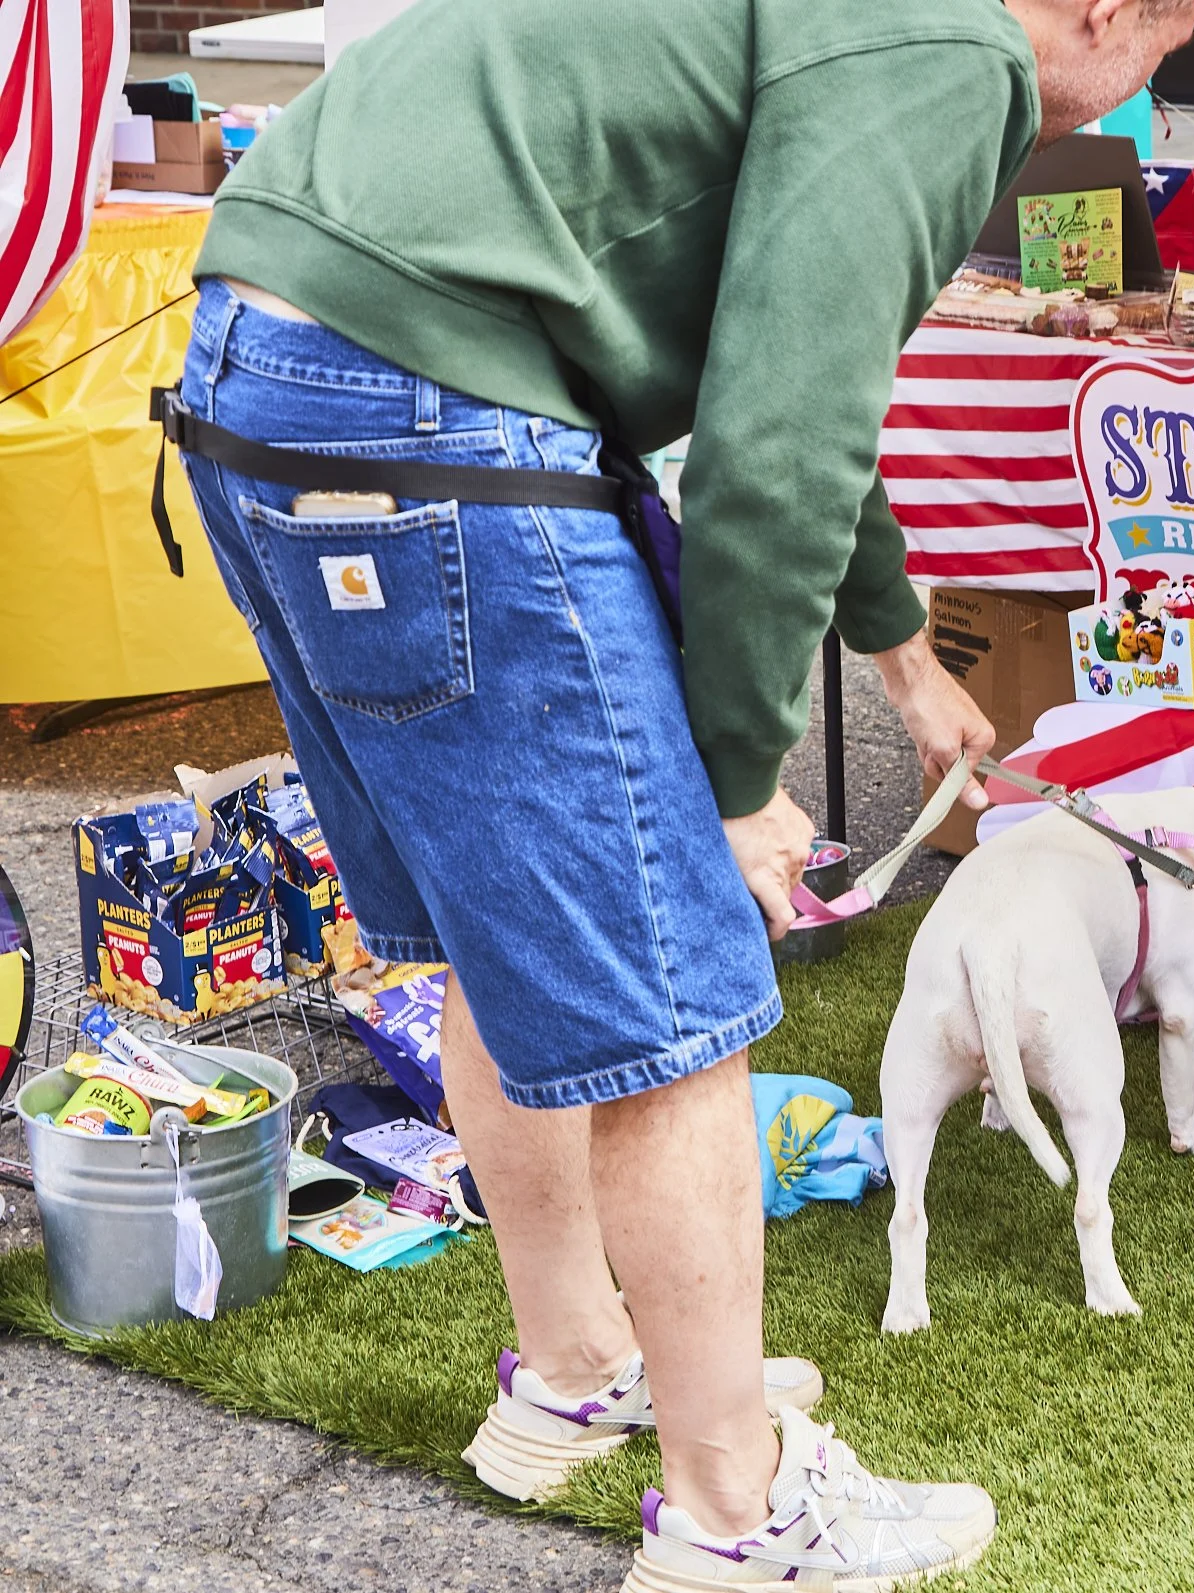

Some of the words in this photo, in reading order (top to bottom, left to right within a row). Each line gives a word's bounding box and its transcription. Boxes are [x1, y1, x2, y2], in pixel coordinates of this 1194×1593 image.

[291, 828, 321, 847] PLANT
[183, 886, 225, 908] PLANTERS
[98, 898, 151, 931] PLANTERS
[209, 911, 266, 946] PLANTERS
[108, 934, 146, 956] PEANUTS
[219, 944, 258, 966] PEANUTS
[128, 1070, 180, 1093] Churu
[89, 1088, 136, 1120] RAWZ
